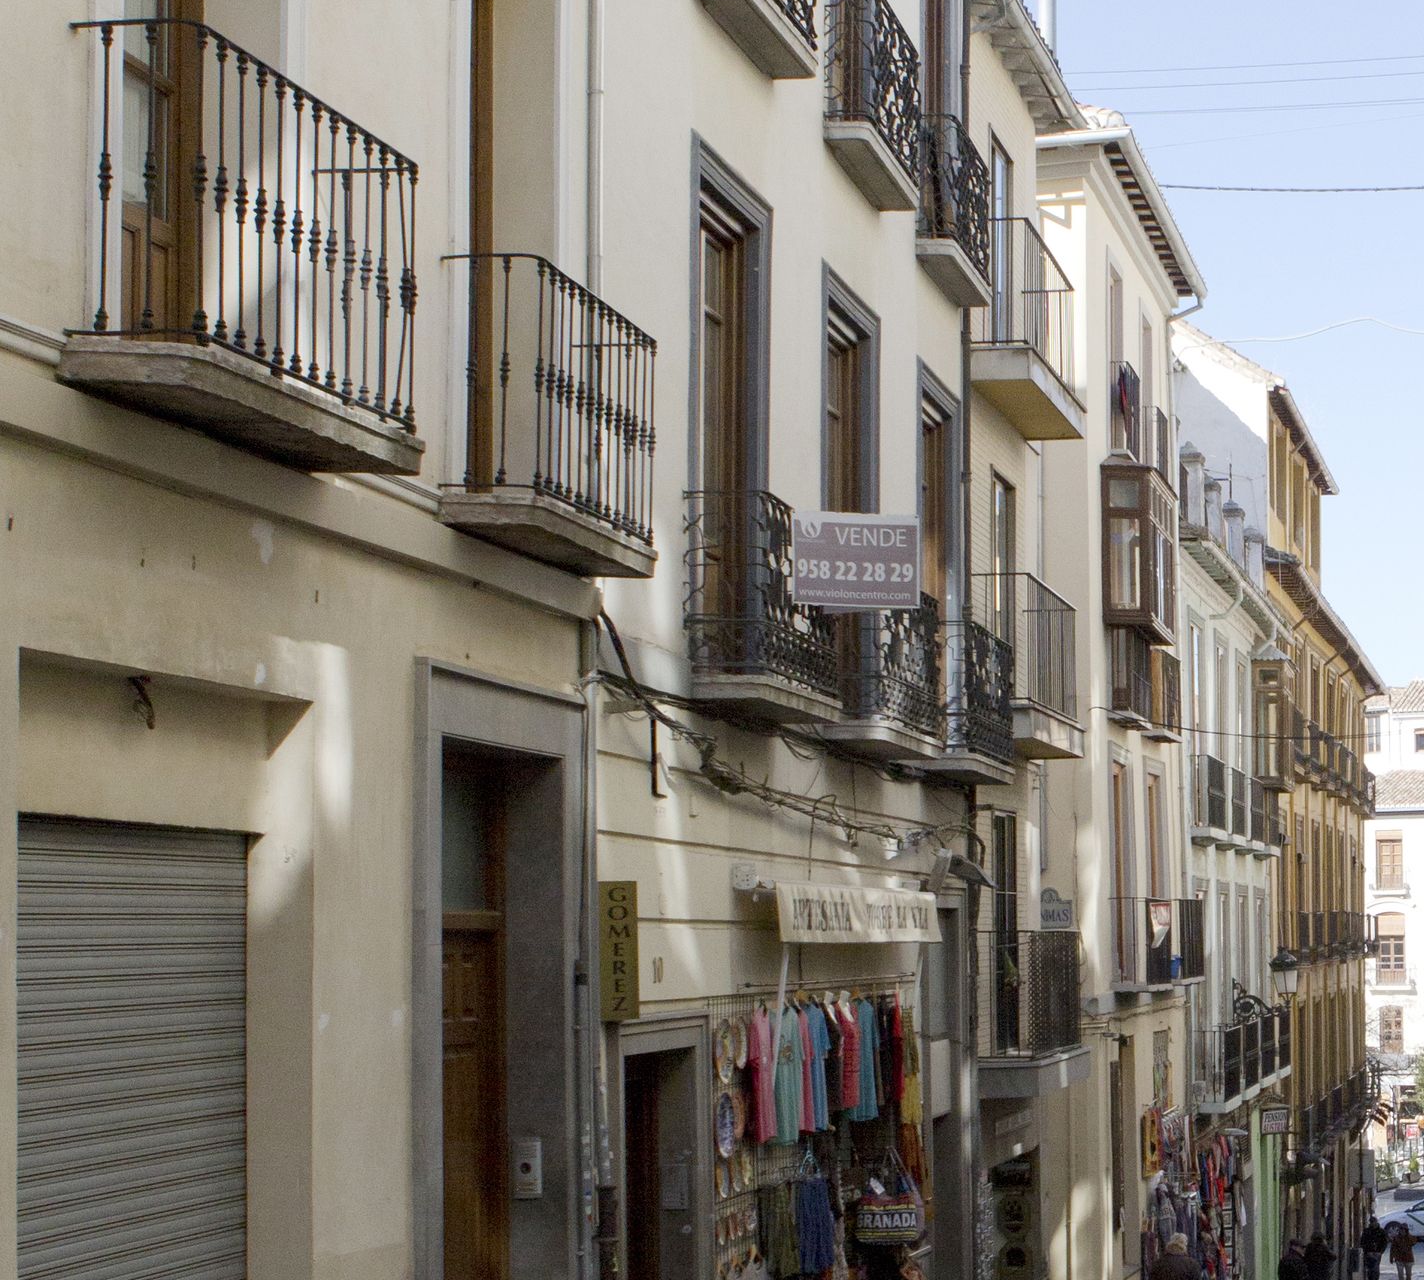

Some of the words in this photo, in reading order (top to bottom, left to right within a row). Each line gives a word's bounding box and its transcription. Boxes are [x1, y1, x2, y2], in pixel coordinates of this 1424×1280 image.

[835, 527, 907, 547] VENDE
[797, 557, 832, 580] 958
[834, 560, 858, 581] 22
[862, 561, 887, 582] 28
[890, 562, 914, 583] 29
[799, 587, 912, 601] www.violoncentro.com
[607, 886, 631, 1012] GOMEREZ
[652, 956, 664, 985] 10
[857, 1213, 917, 1228] GRANADA
